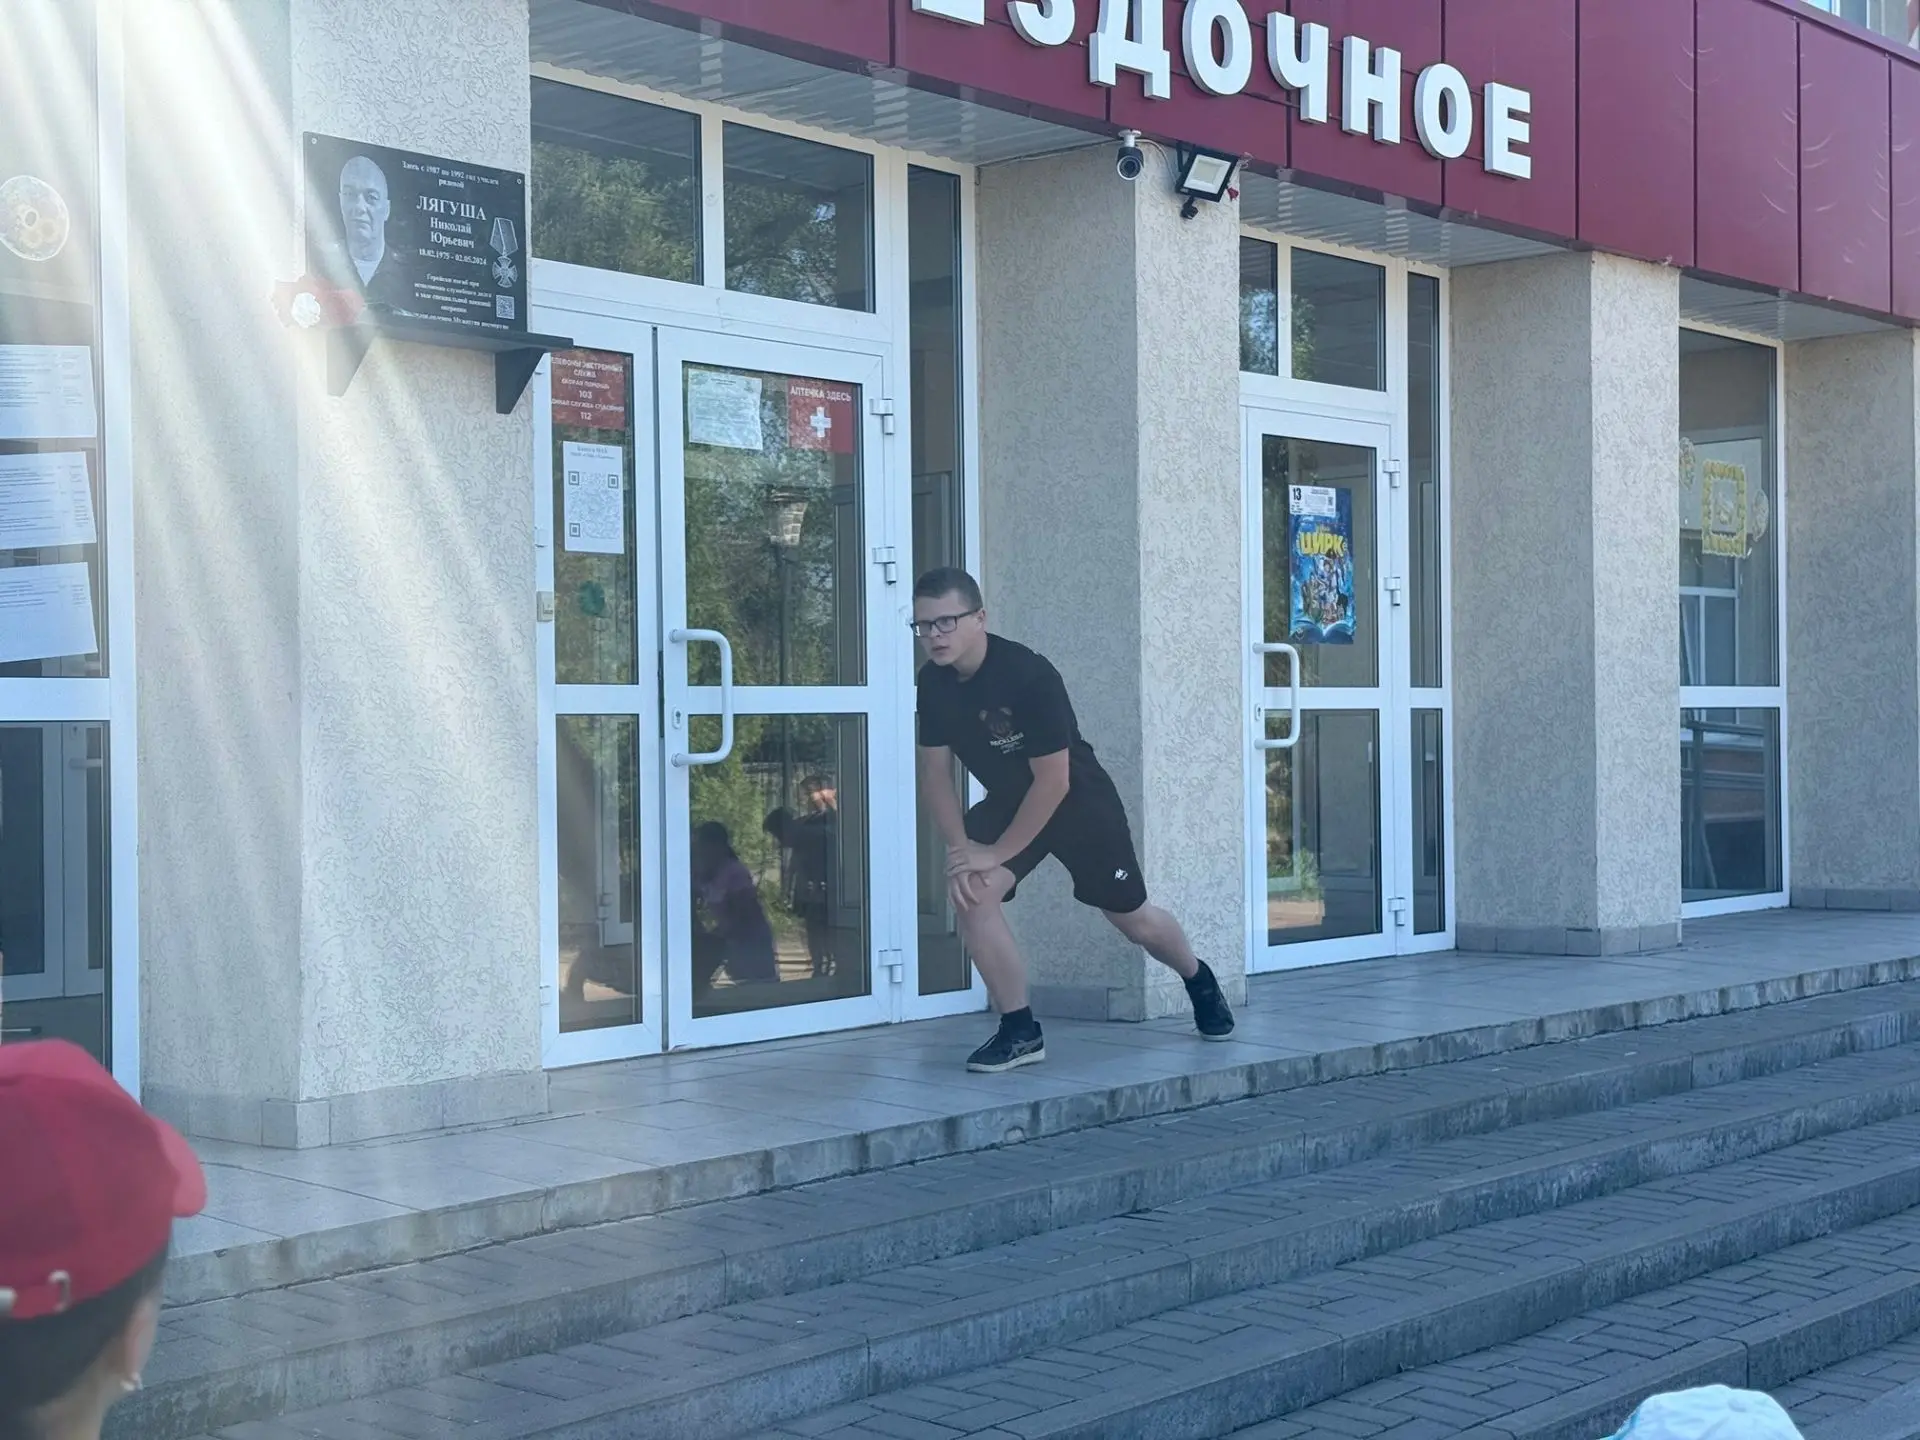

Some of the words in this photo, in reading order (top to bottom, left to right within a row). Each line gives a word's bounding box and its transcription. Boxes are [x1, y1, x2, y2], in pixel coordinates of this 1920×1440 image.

[911, 0, 1532, 180] ДОЧНОЕ
[450, 170, 465, 179] 1992
[416, 195, 487, 221] ЛЯГУША
[430, 216, 472, 234] Николай
[430, 231, 475, 249] Юрьевич
[579, 390, 593, 399] 103
[790, 385, 825, 399] АПТЕЧКА
[826, 390, 852, 402] ЗДЕСЬ
[580, 411, 592, 421] 112
[1292, 487, 1302, 501] 13
[1300, 530, 1344, 558] ЦИРК
